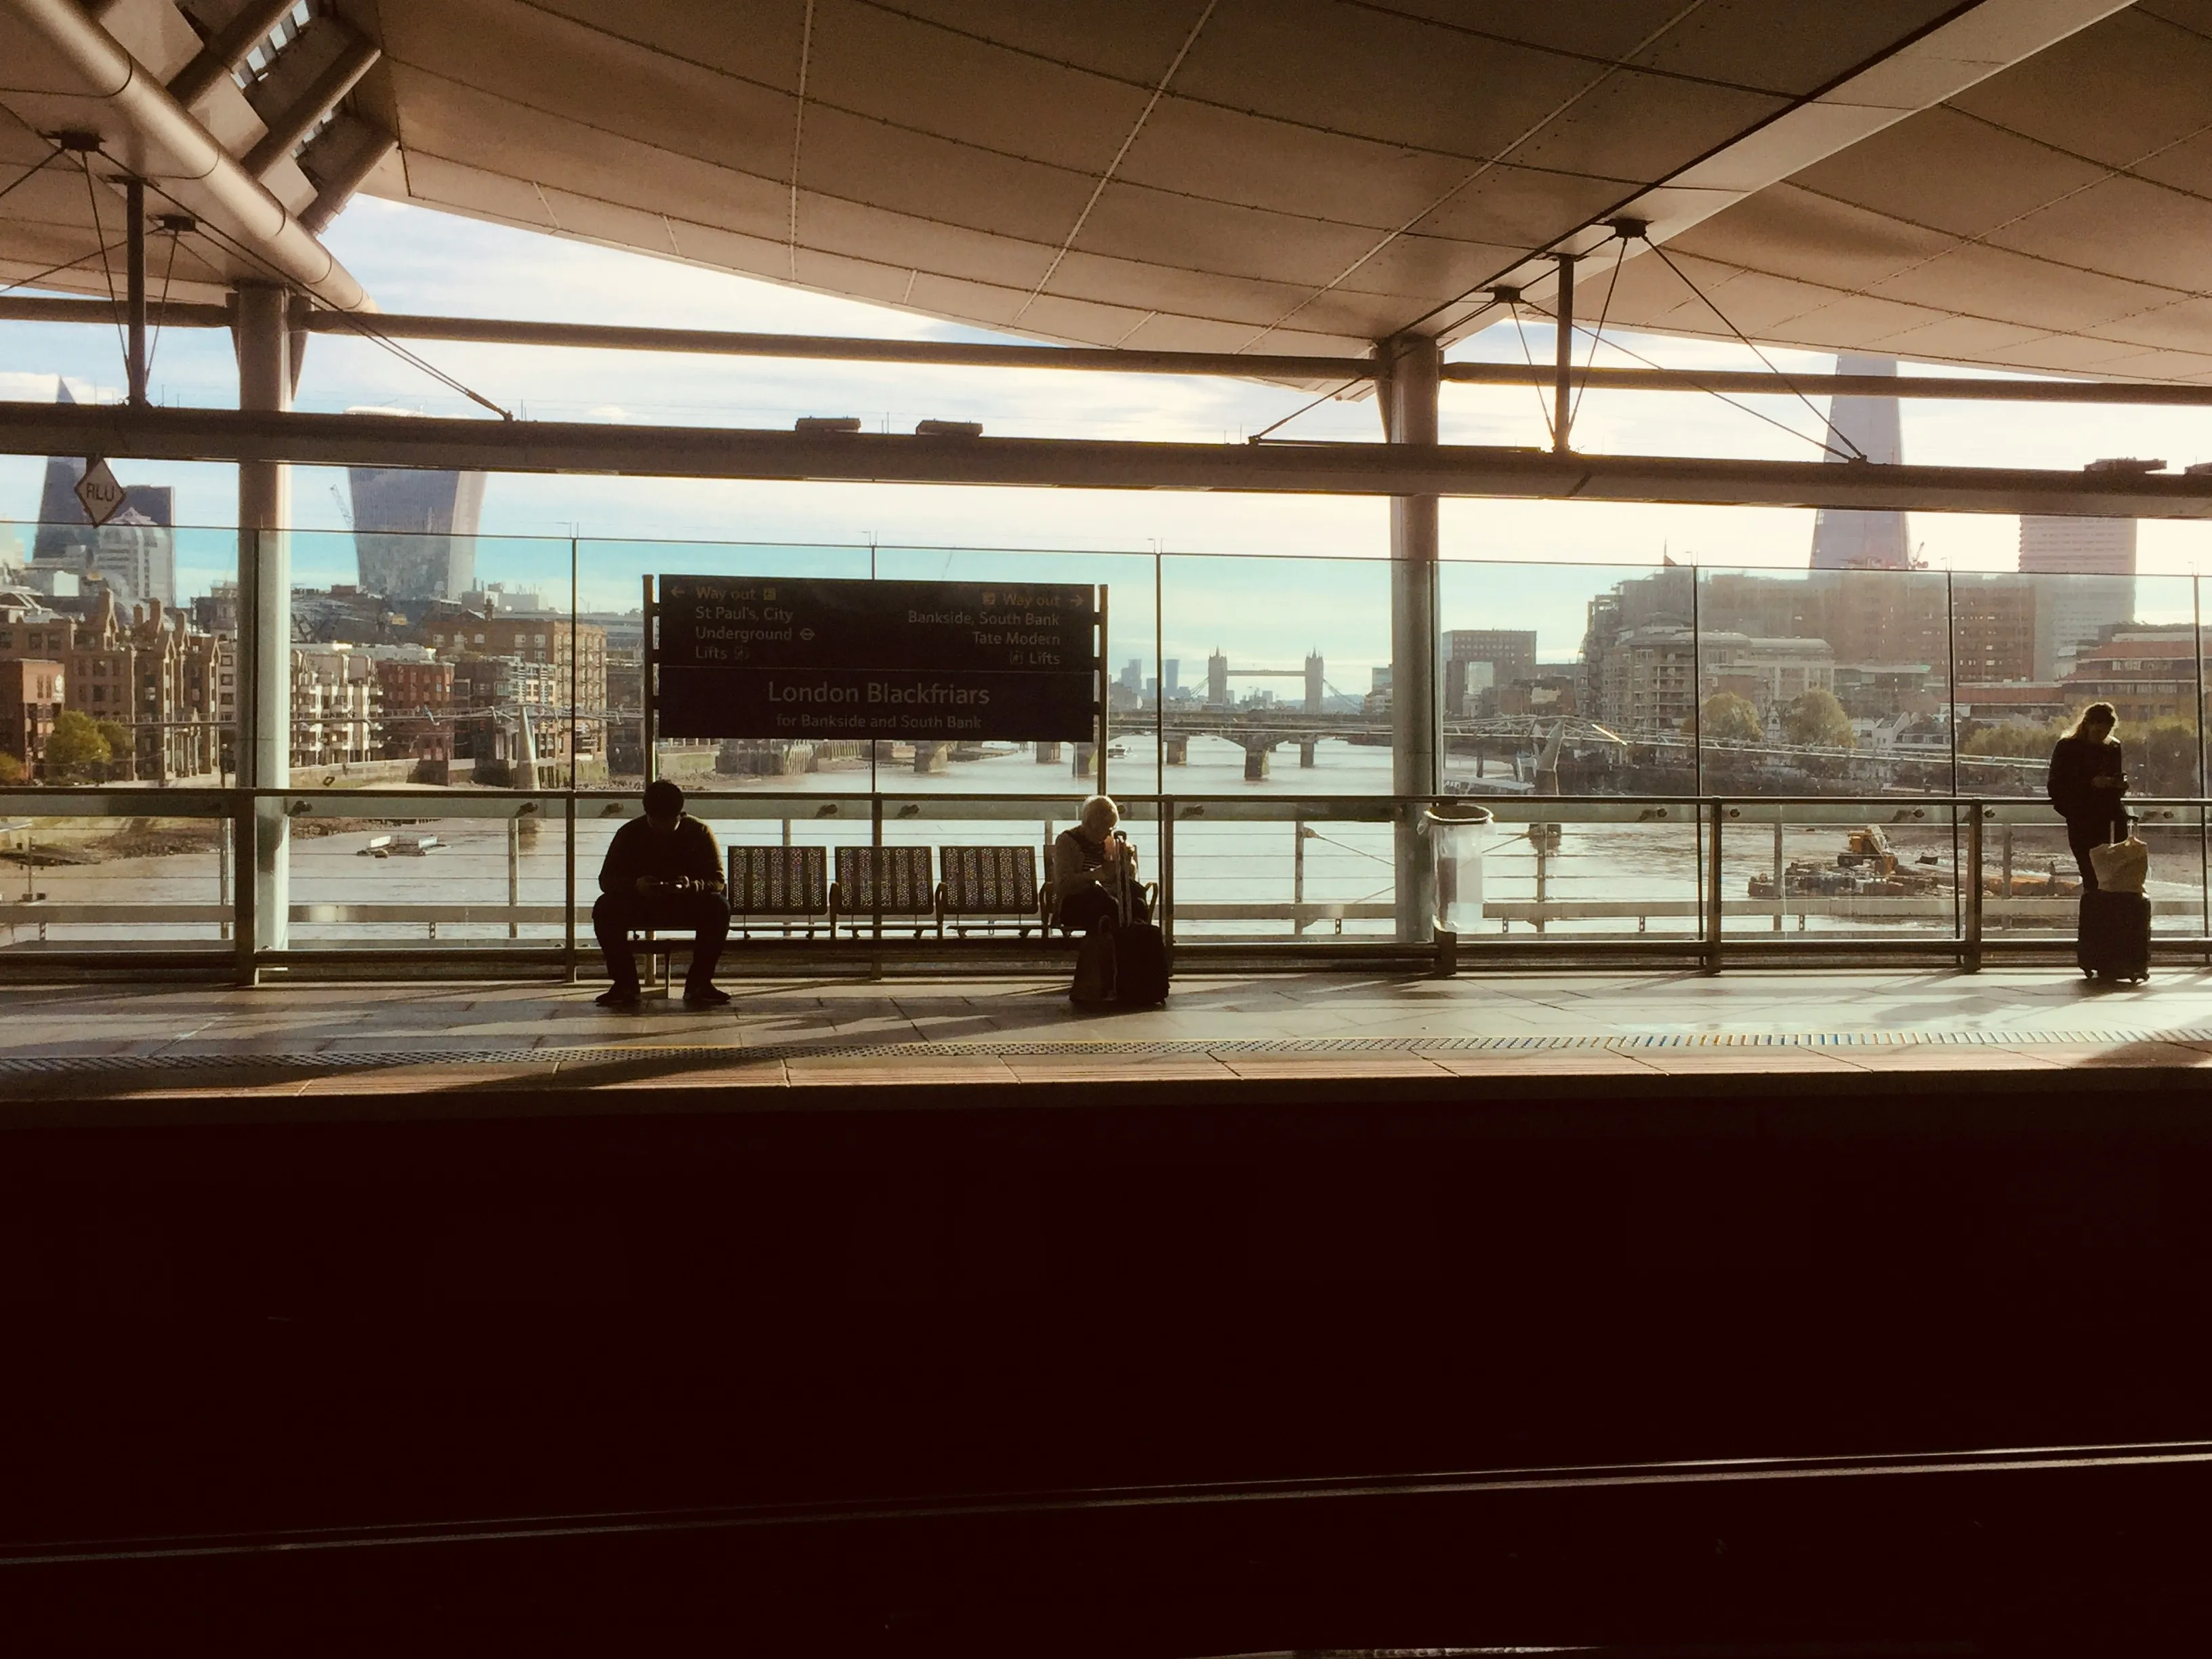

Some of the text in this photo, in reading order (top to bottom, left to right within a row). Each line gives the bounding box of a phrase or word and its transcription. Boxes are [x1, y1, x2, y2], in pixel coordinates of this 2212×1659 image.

[696, 587, 757, 602] Way out
[1003, 593, 1061, 609] Way out
[695, 606, 794, 624] St Paul's, City
[908, 610, 1060, 626] Bankside, South Bank
[695, 626, 792, 642] Underground
[972, 631, 1061, 646] Tate Modern
[695, 646, 728, 660] Lifts
[1029, 651, 1061, 665] Lifts
[768, 681, 990, 705] London Blackfriars
[776, 714, 982, 729] for Bankside and South Bank
